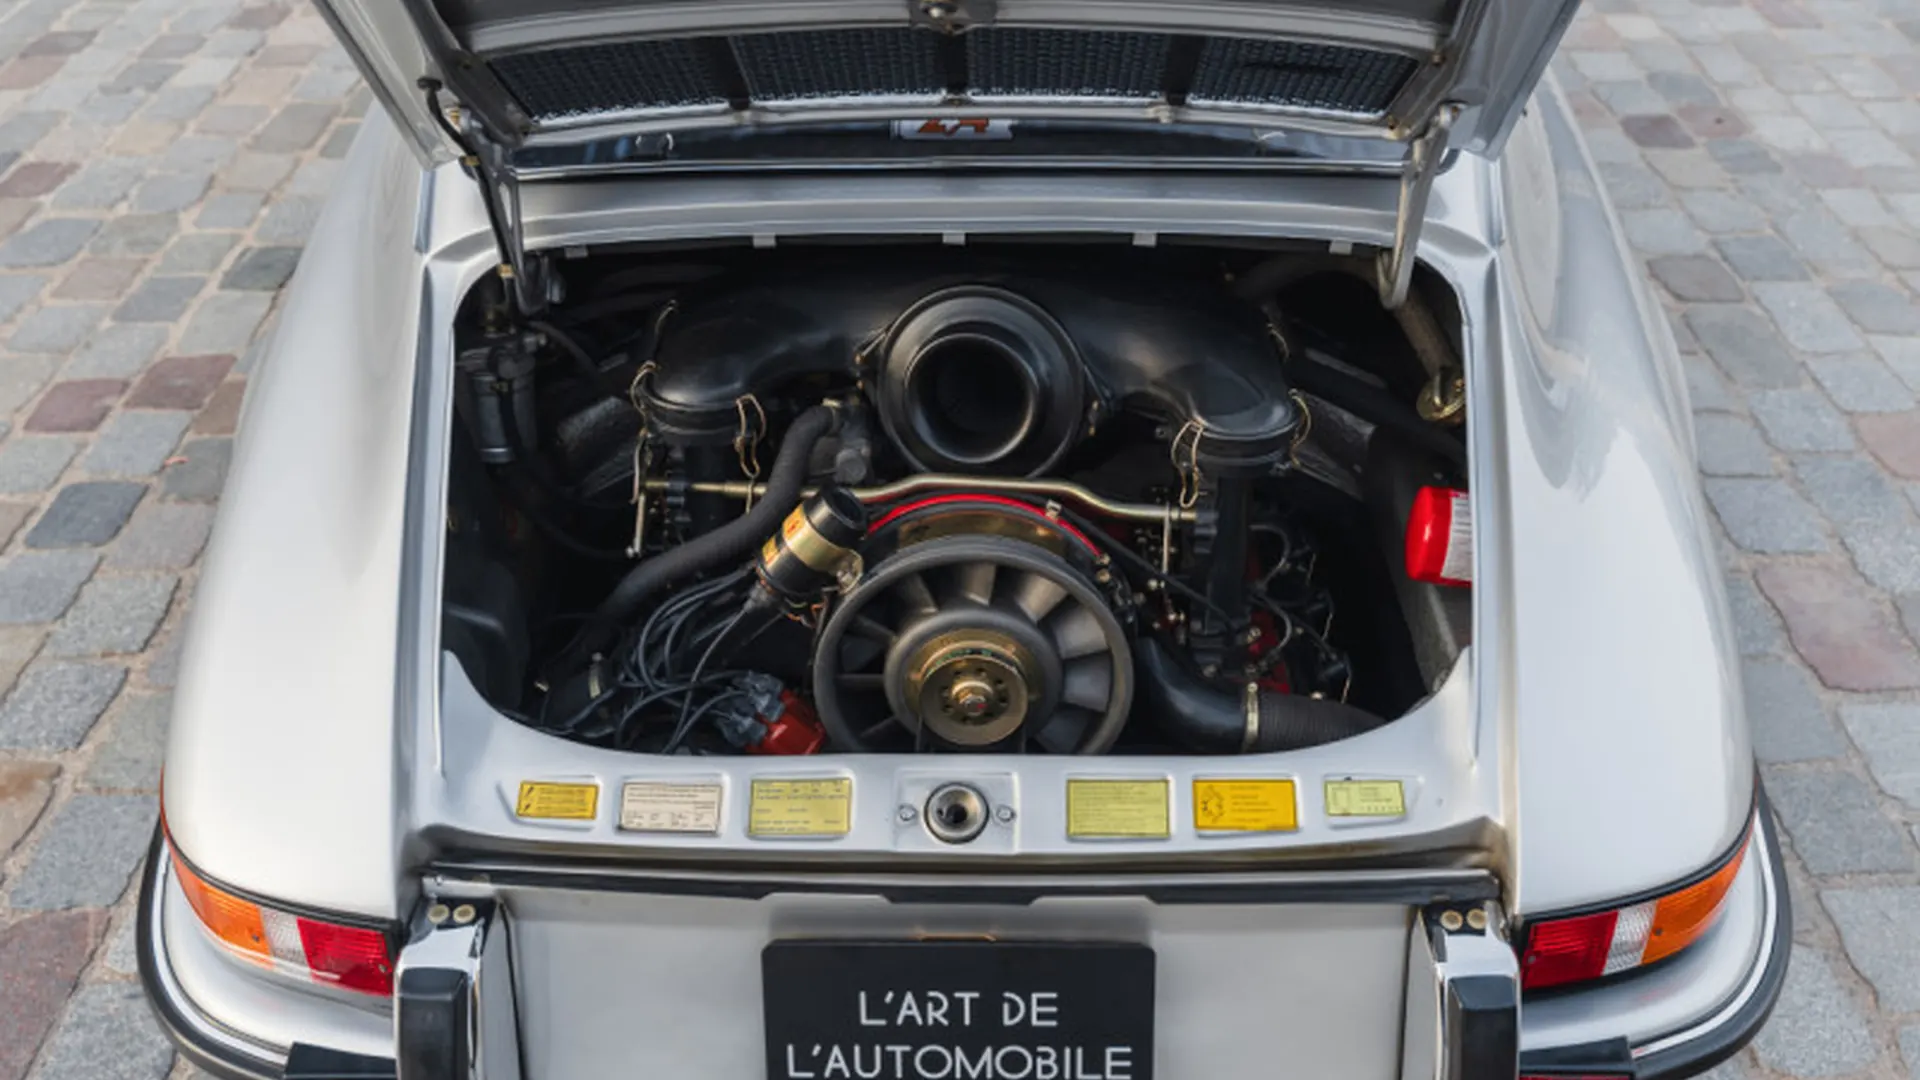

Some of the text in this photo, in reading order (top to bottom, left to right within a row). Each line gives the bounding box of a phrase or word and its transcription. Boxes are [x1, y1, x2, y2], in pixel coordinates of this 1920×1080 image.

[859, 990, 1058, 1027] L'ART DE
[787, 1043, 1132, 1080] L'AUTOMOBILE
